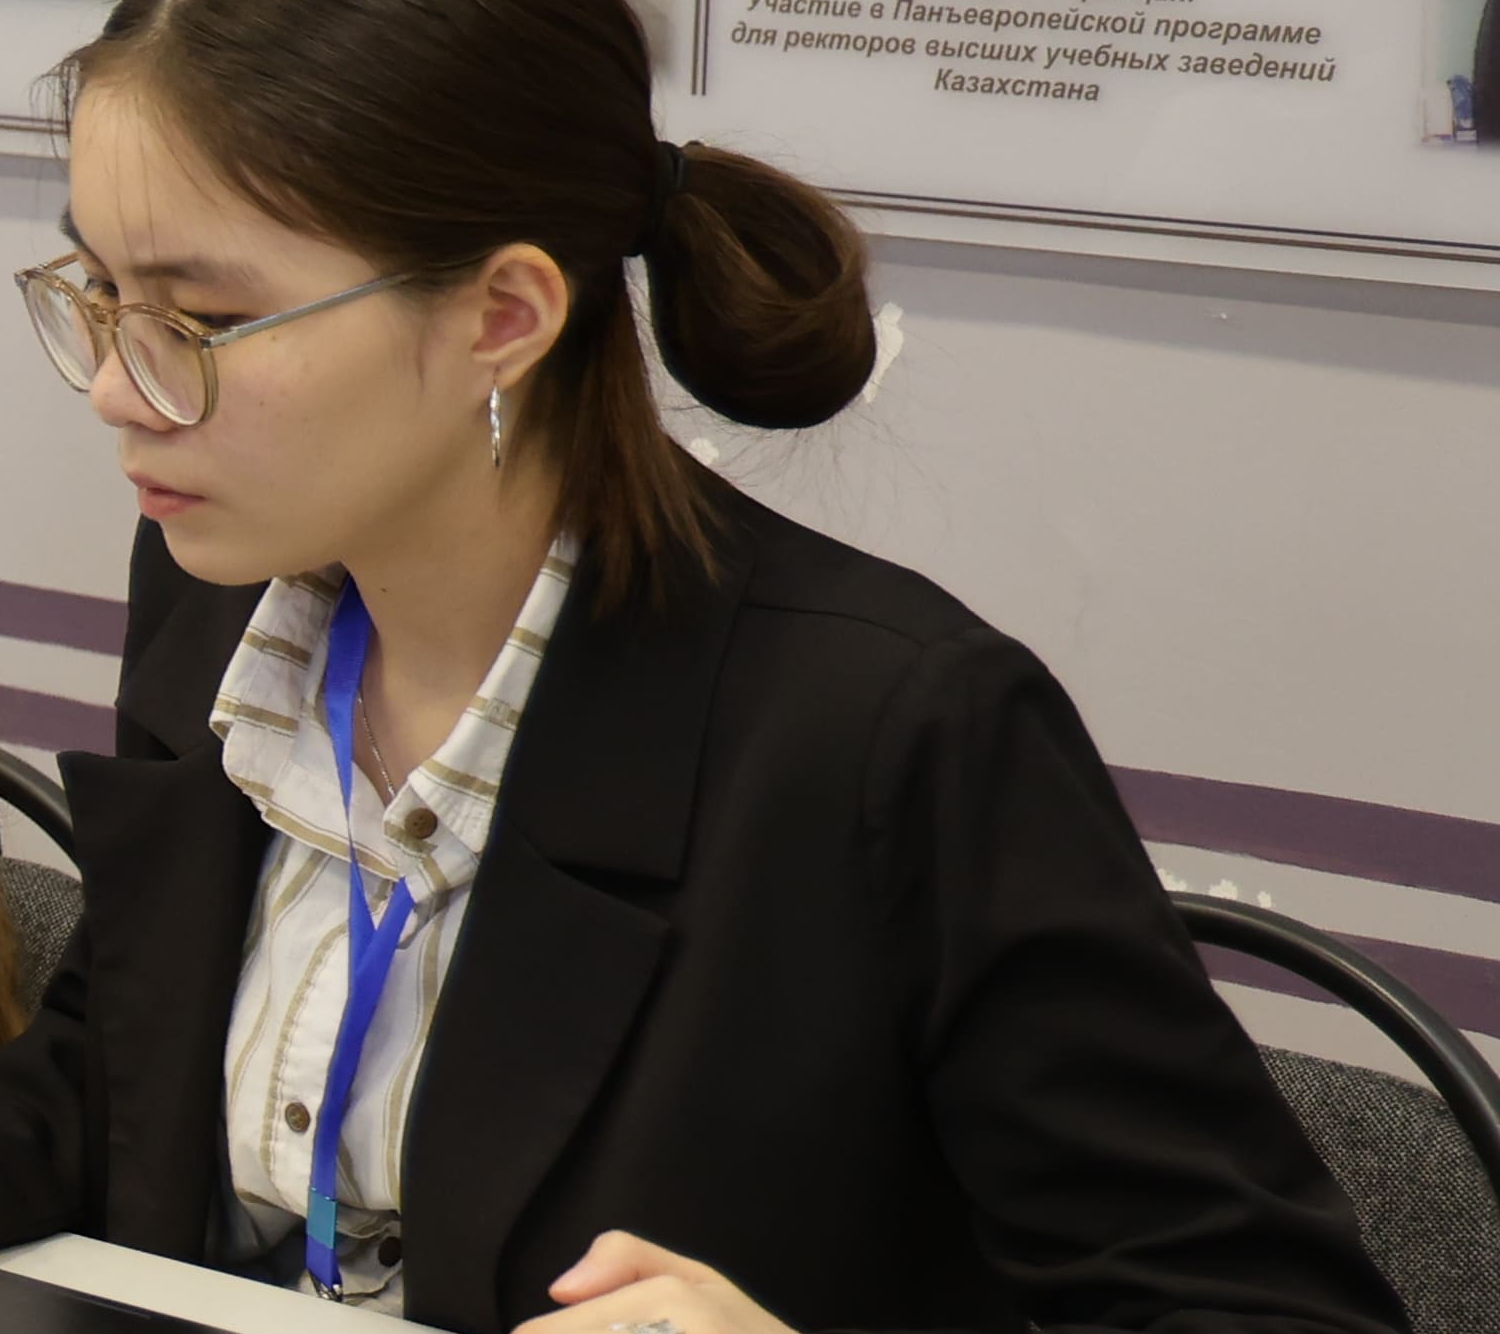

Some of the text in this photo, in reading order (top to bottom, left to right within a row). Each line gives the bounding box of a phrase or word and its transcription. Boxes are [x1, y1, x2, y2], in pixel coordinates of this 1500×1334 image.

[869, 2, 885, 20] в
[1152, 18, 1322, 46] программе
[730, 20, 1337, 83] для ректоров высших учебных заведений
[933, 67, 1101, 102] Казахстана
